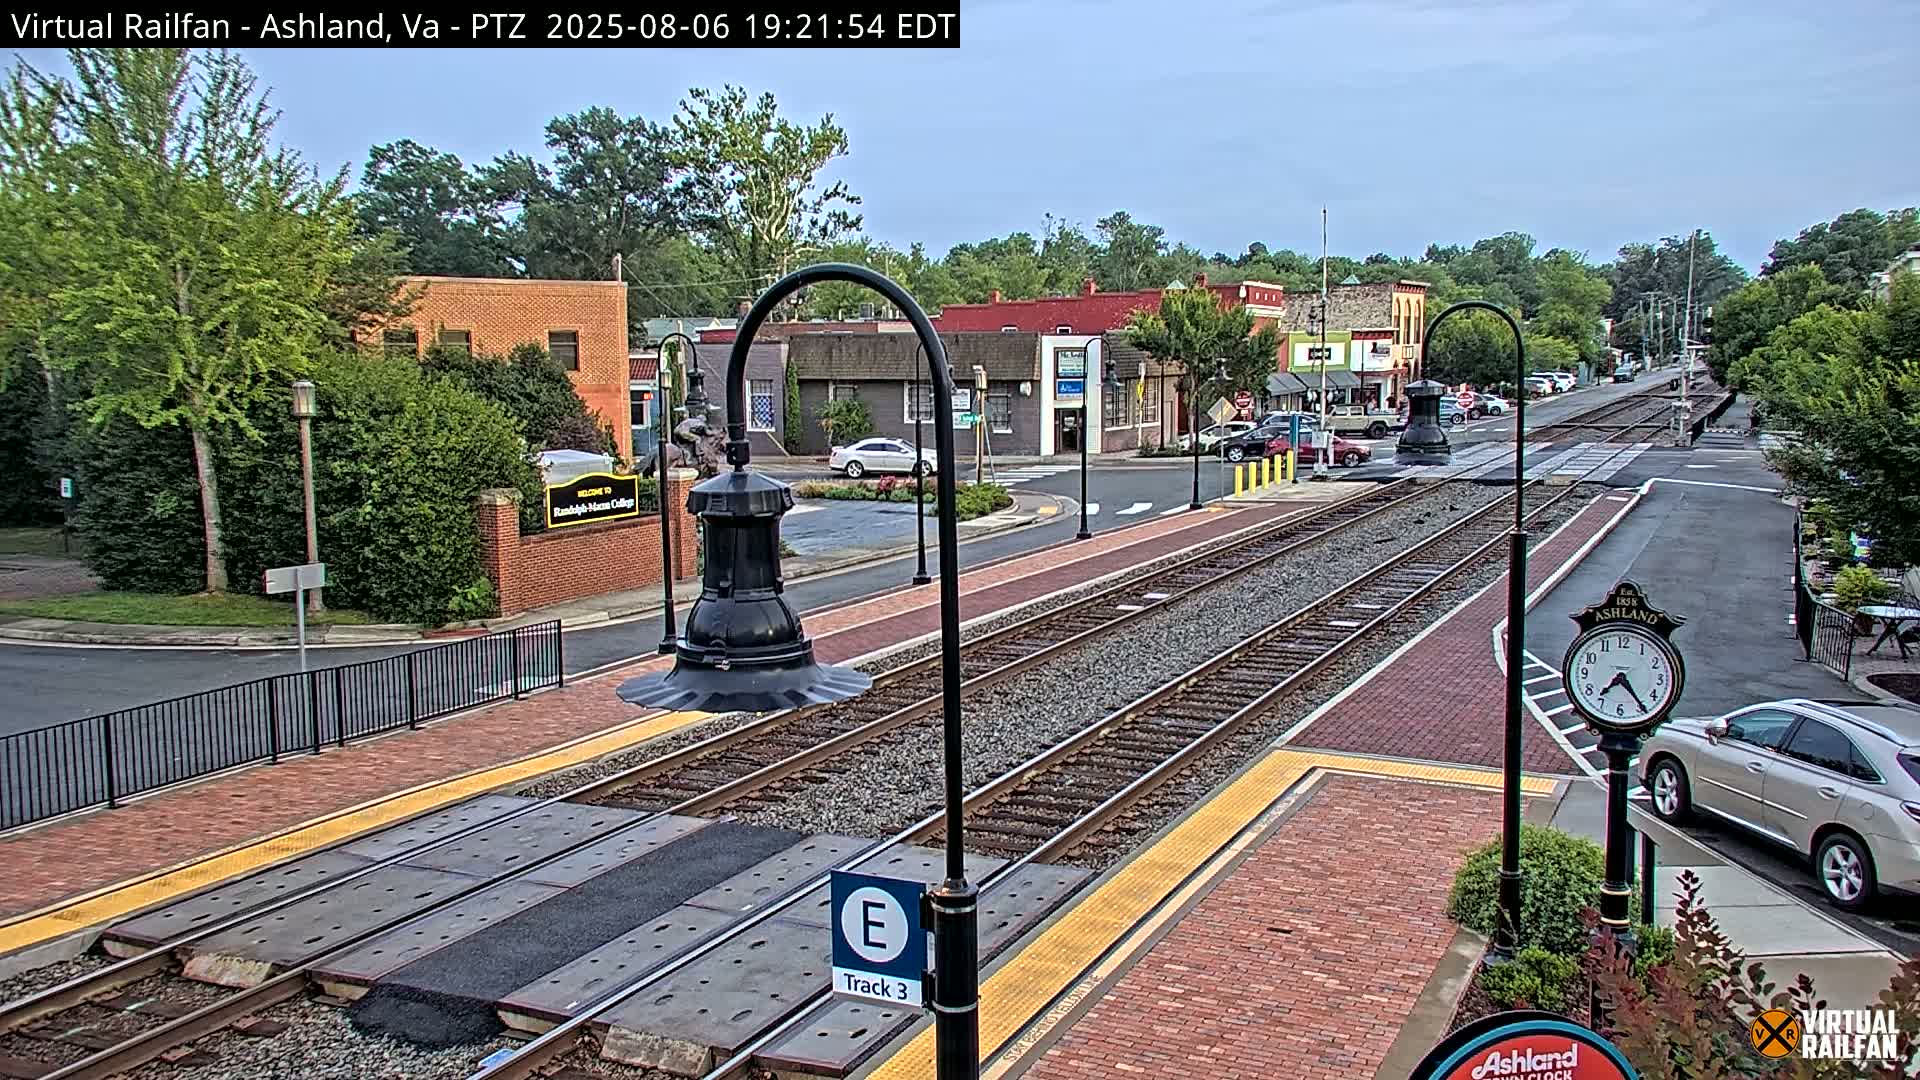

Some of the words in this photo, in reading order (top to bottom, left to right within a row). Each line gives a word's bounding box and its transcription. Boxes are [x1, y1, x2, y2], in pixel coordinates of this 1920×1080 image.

[577, 488, 603, 498] WELCOME
[604, 487, 612, 495] TO
[610, 498, 635, 510] College
[1620, 588, 1636, 596] Est.
[1595, 607, 1658, 625] ASHLAND
[1601, 640, 1610, 653] 11
[1617, 637, 1630, 649] 12
[1640, 643, 1645, 655] 1
[1586, 652, 1597, 665] 10
[1652, 657, 1660, 670] 2
[1581, 667, 1589, 680] 9
[1656, 674, 1665, 686] 3
[1585, 683, 1594, 696] 8
[1649, 689, 1658, 702] 4
[1598, 698, 1605, 710] 7
[1616, 704, 1624, 717] 6
[862, 900, 887, 949] E
[843, 972, 892, 998] Track
[897, 982, 908, 1001] 3
[1471, 1042, 1578, 1080] Ashland
